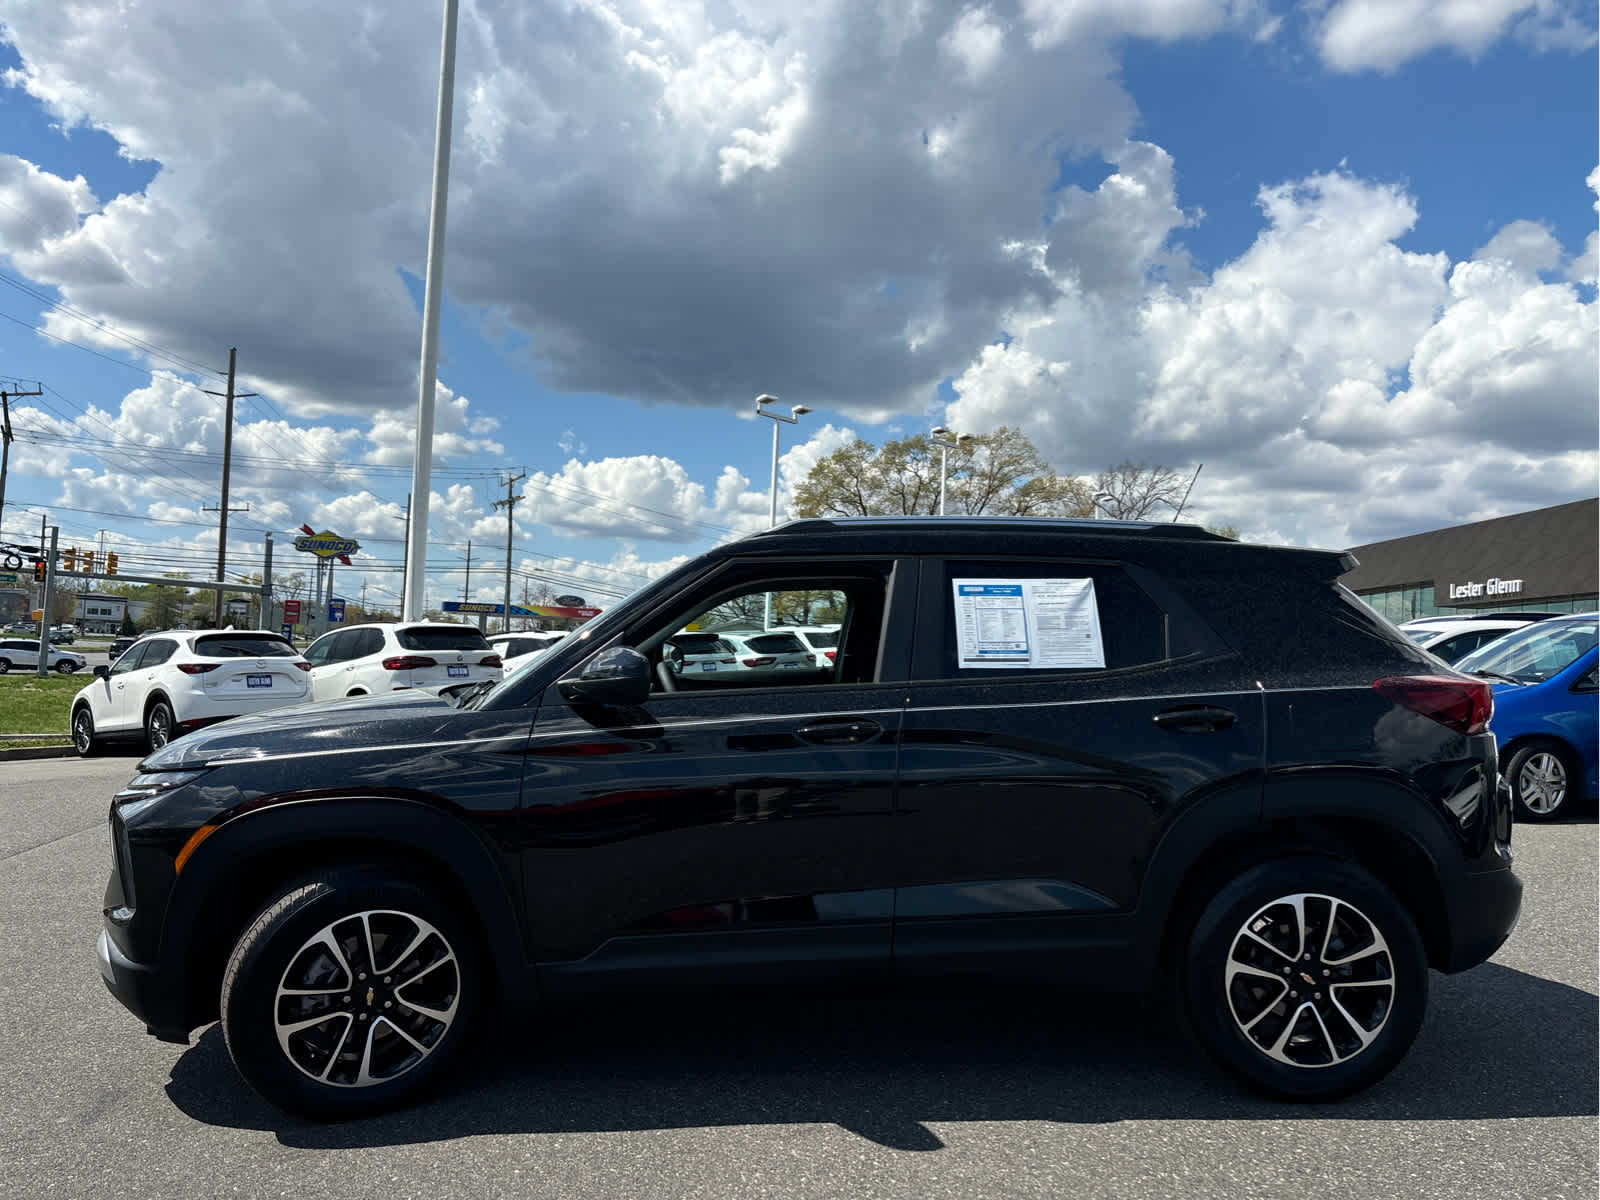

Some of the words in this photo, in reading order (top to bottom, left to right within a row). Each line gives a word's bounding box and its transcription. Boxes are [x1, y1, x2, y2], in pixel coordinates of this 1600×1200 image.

[298, 539, 353, 552] SUNOCO
[1449, 583, 1484, 600] Lester
[1487, 578, 1523, 595] Glenn
[458, 603, 497, 612] SUNOCO
